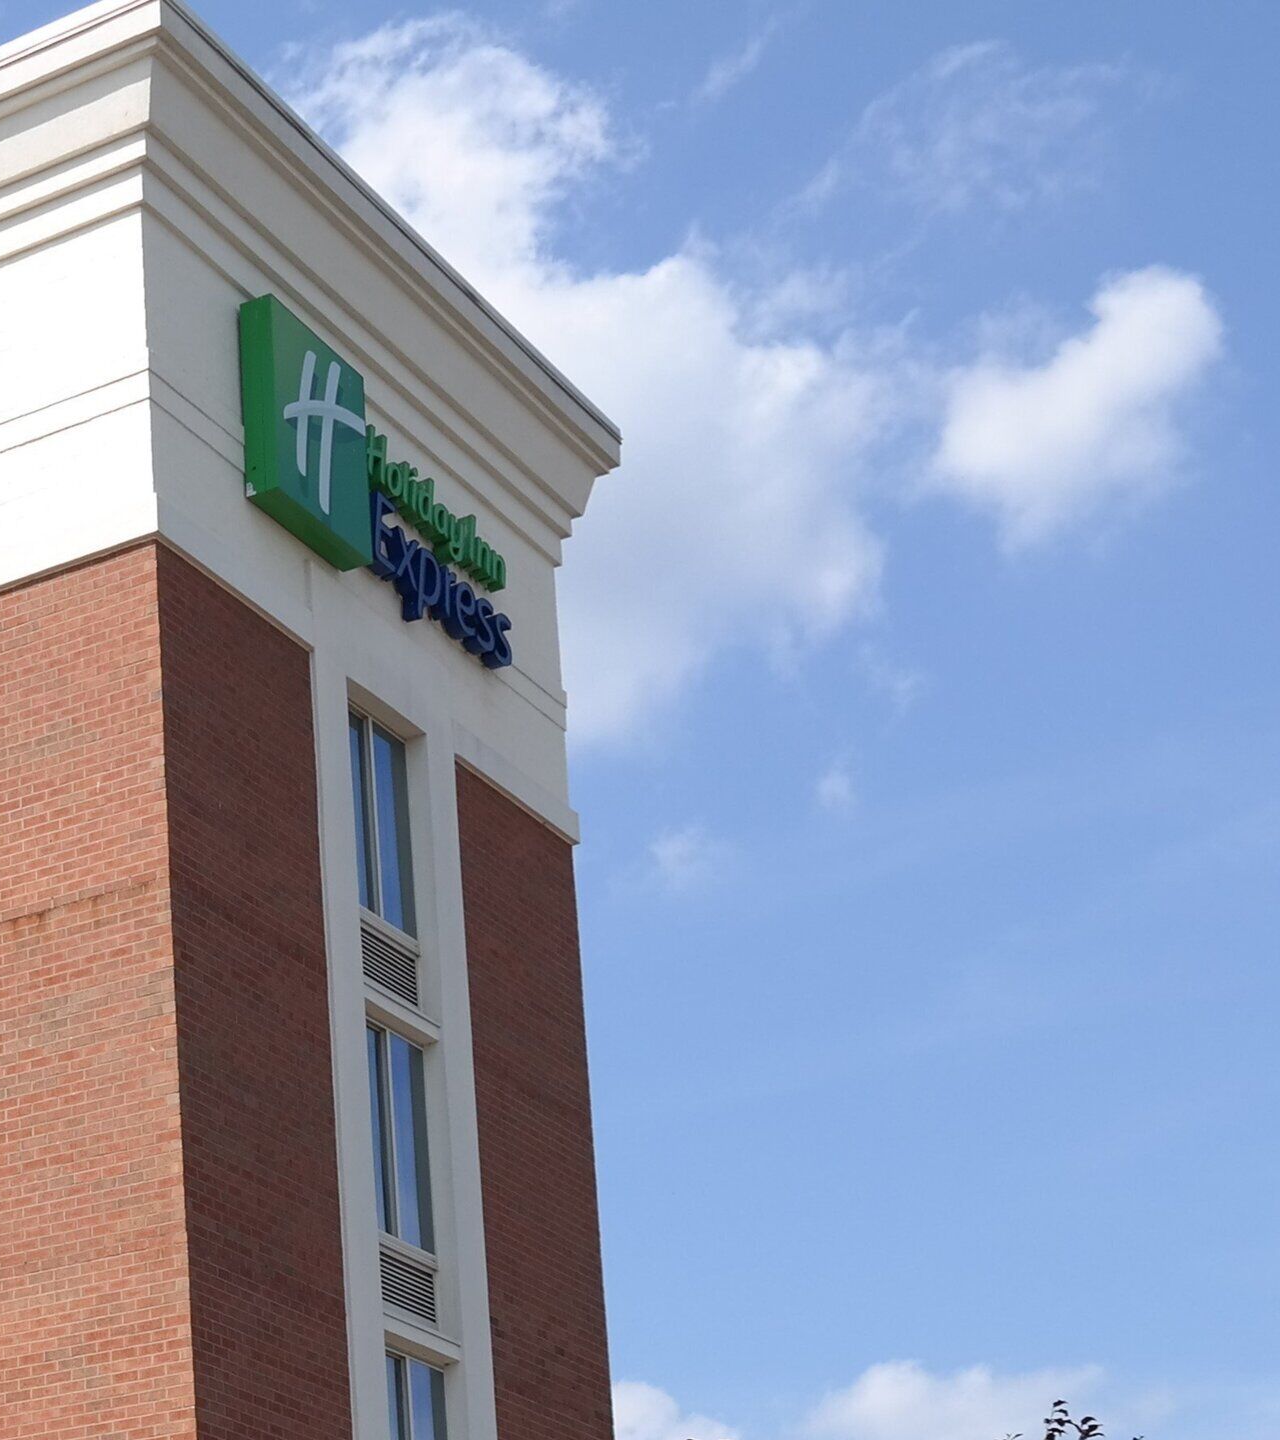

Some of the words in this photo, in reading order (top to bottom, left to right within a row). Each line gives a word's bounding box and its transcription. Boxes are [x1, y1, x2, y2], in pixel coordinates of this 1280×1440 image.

[366, 424, 465, 562] Holiday
[465, 514, 506, 591] Inn
[373, 491, 512, 668] Express
